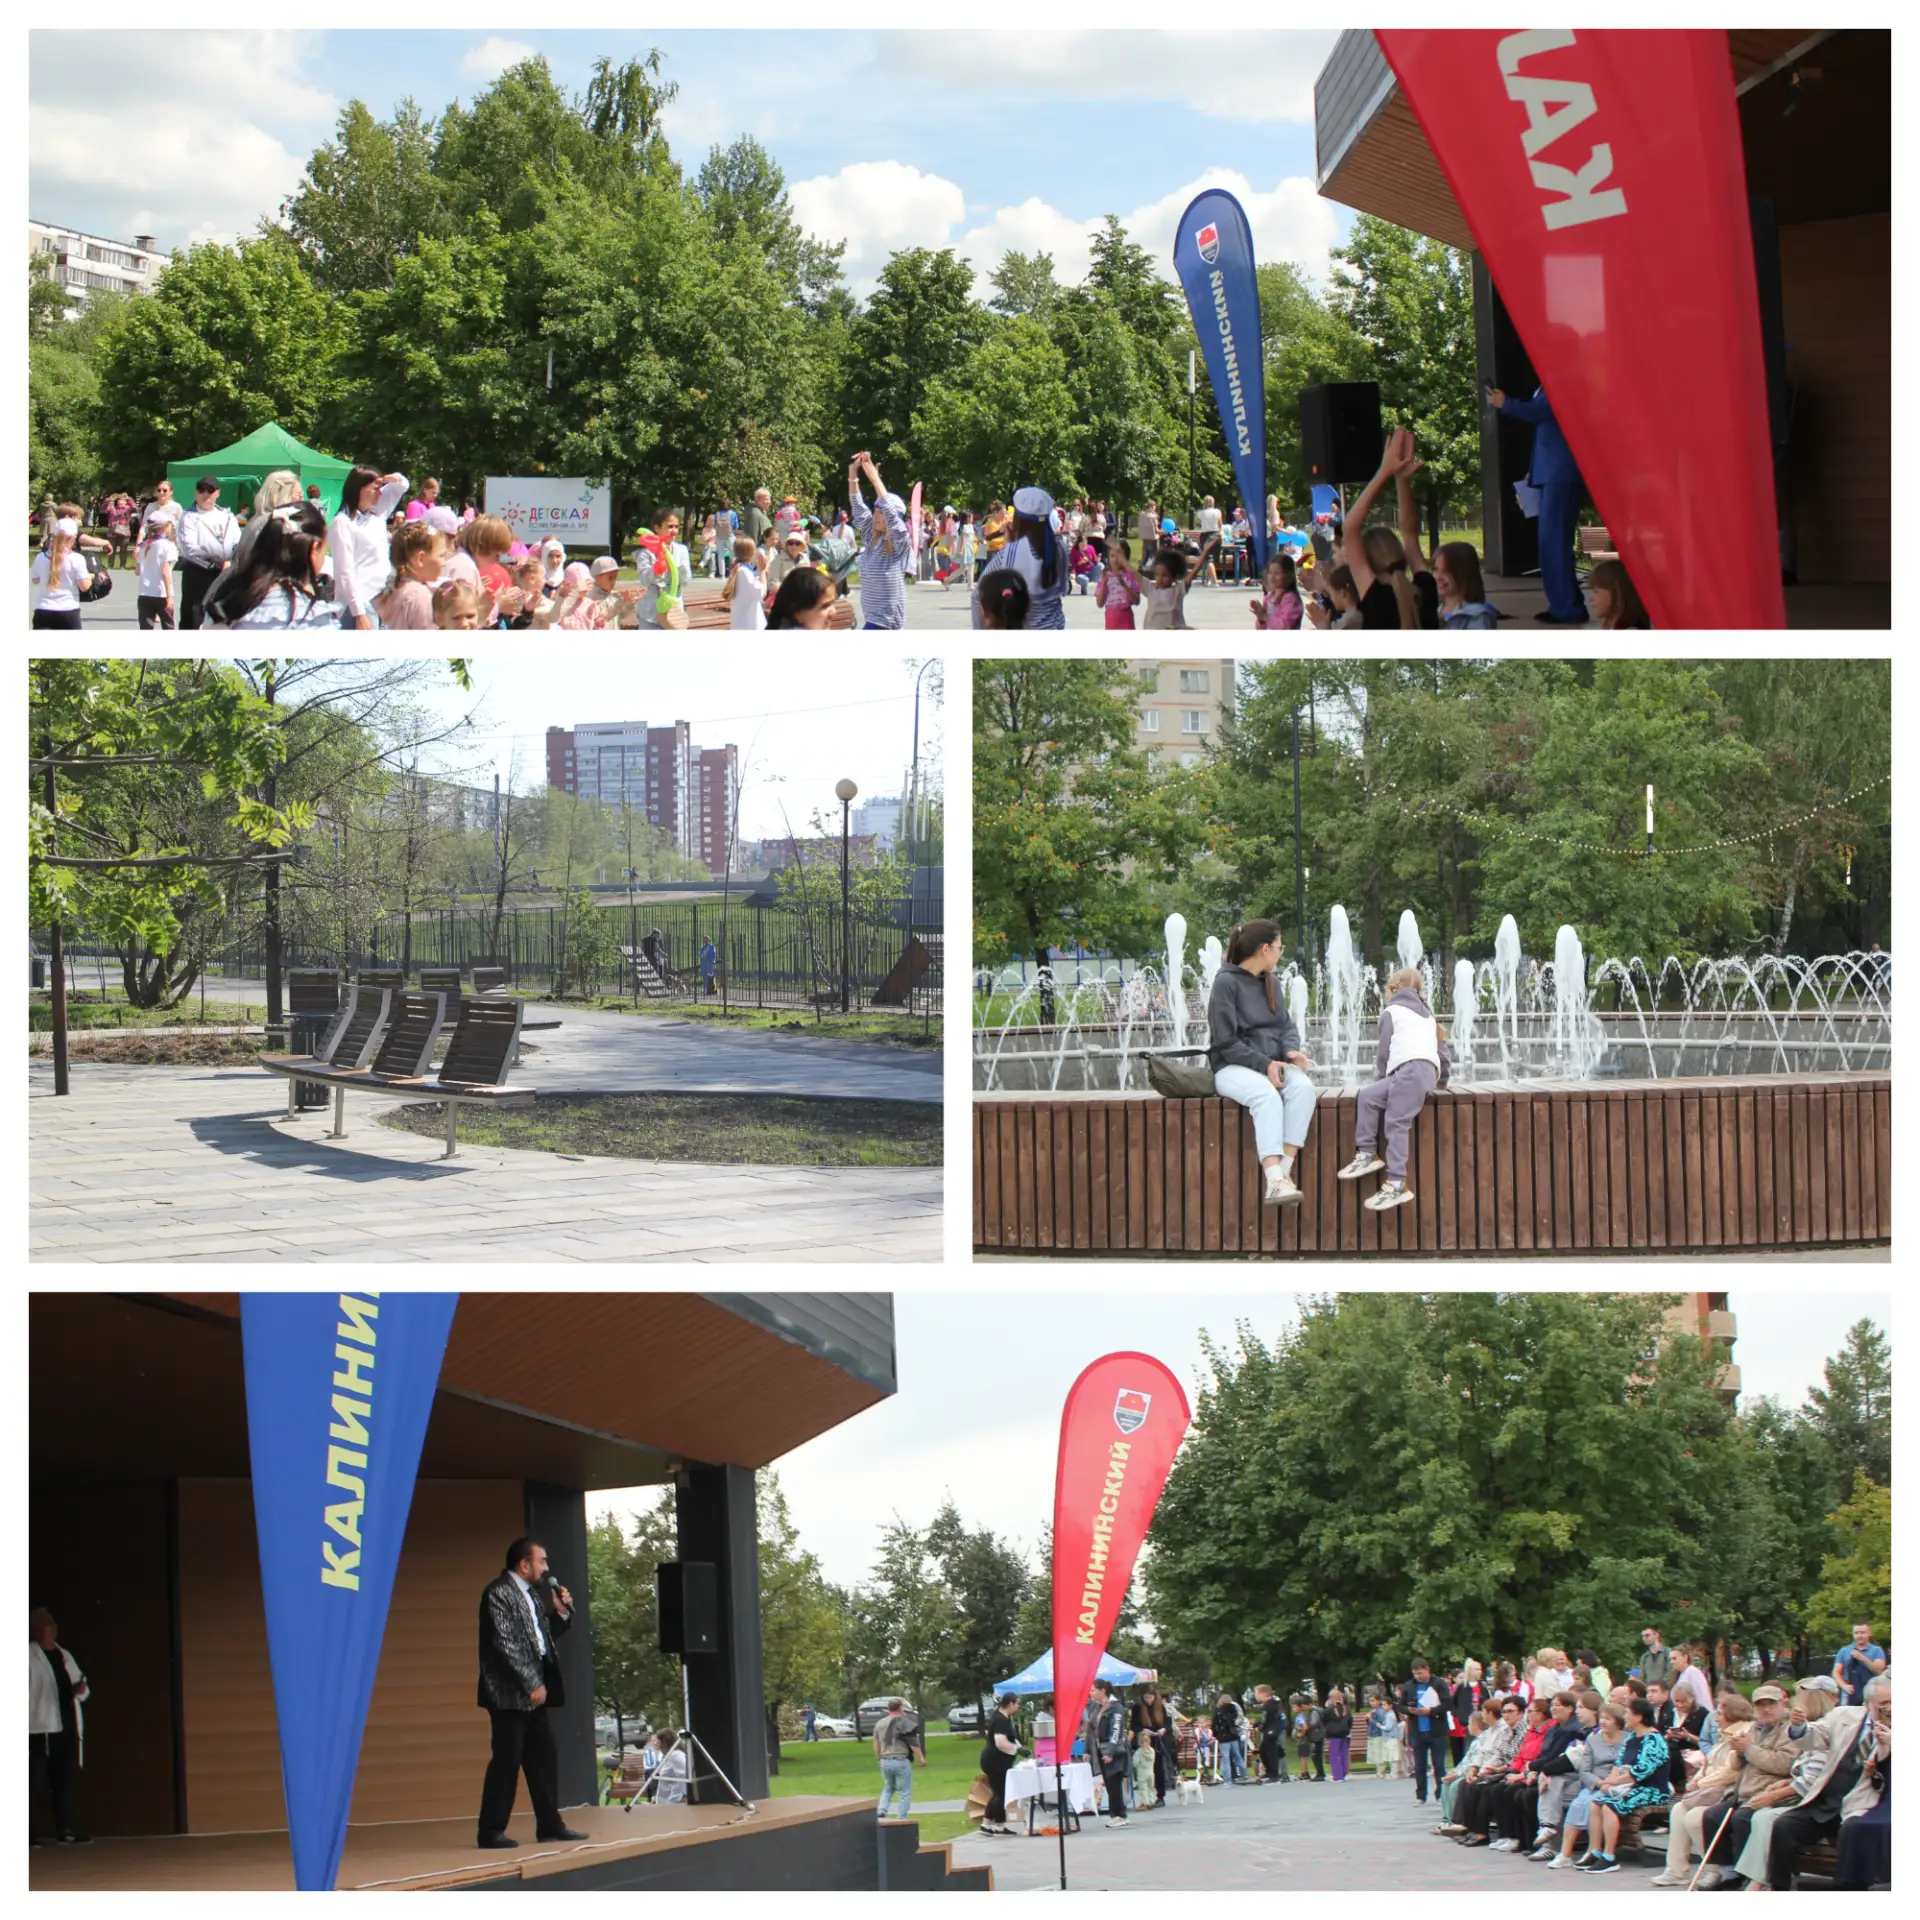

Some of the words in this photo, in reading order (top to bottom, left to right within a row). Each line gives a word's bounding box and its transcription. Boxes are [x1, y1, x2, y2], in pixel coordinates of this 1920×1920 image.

[529, 507, 589, 521] ДЕТСКАЯ
[321, 1292, 380, 1592] КАЛИНИ
[1075, 1440, 1132, 1645] КАЛИНИНСКИЙ
